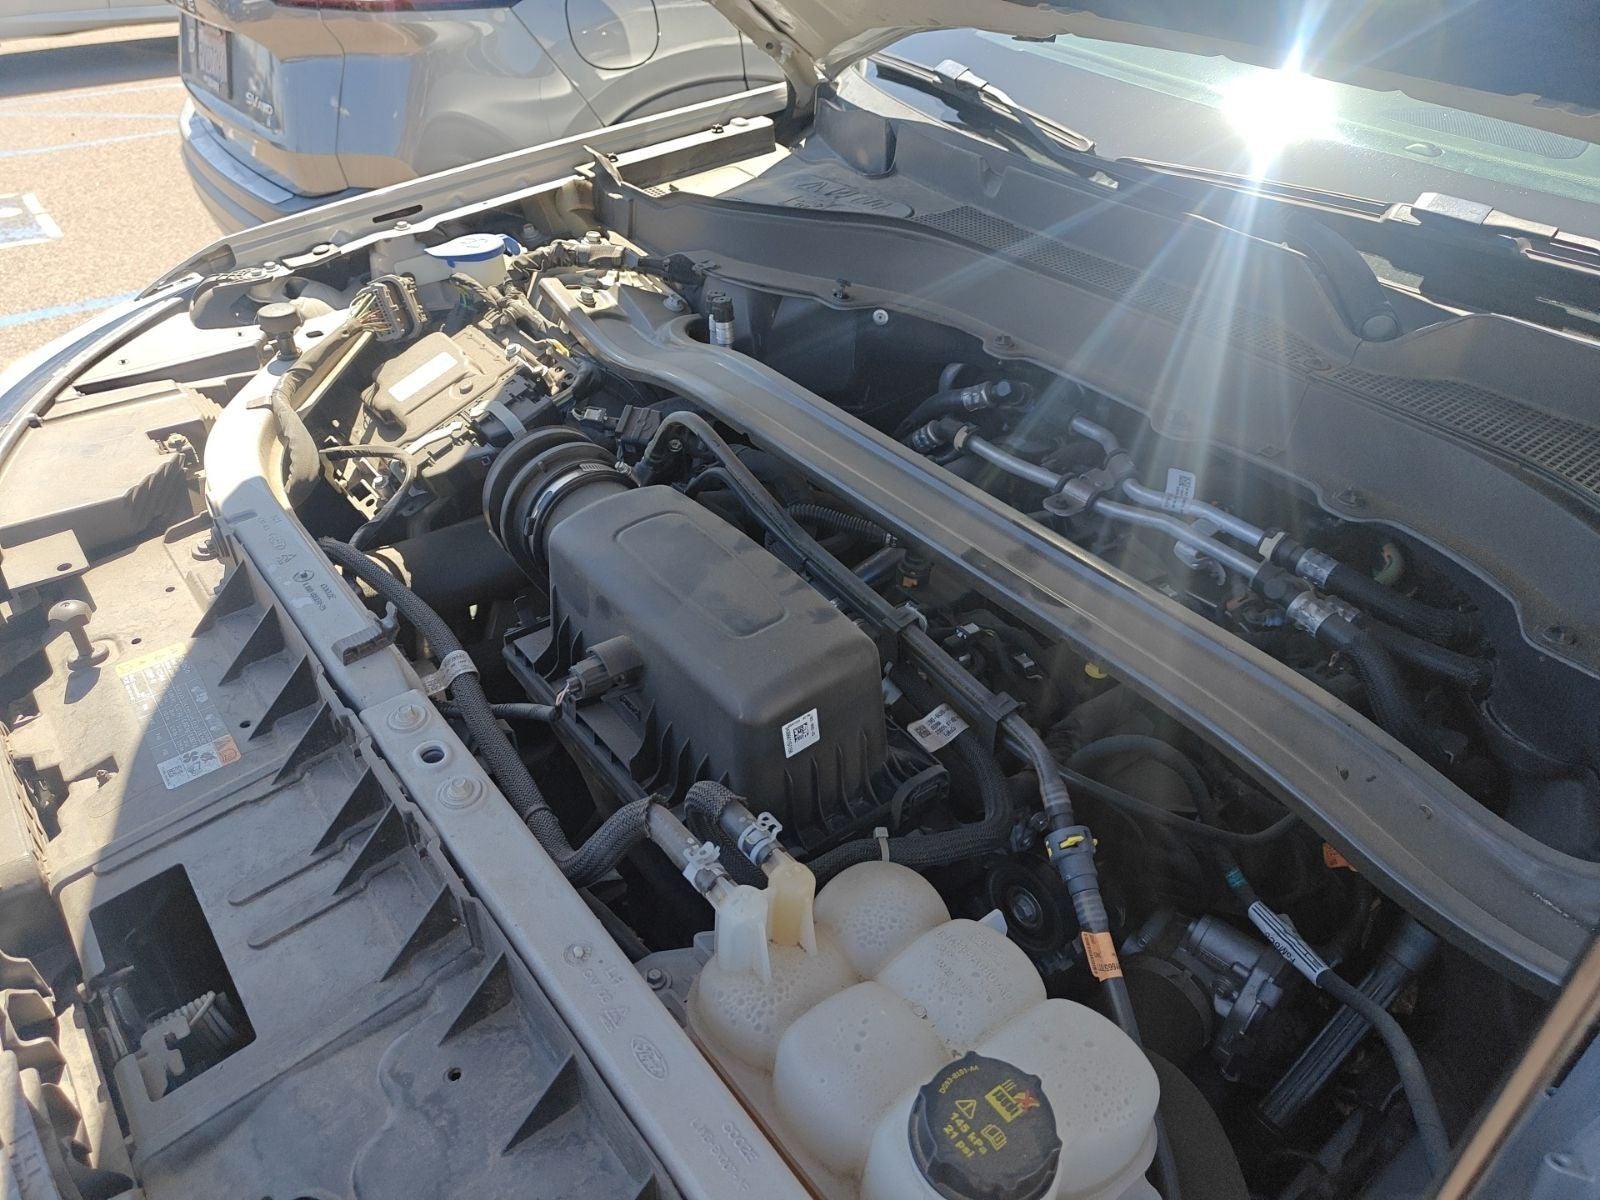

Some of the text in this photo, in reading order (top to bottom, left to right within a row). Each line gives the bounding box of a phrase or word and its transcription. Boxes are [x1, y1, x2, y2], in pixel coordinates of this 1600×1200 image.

[1264, 931, 1296, 963] FoMoCo
[944, 1125, 959, 1140] 21
[951, 1112, 987, 1154] 145 kPa
